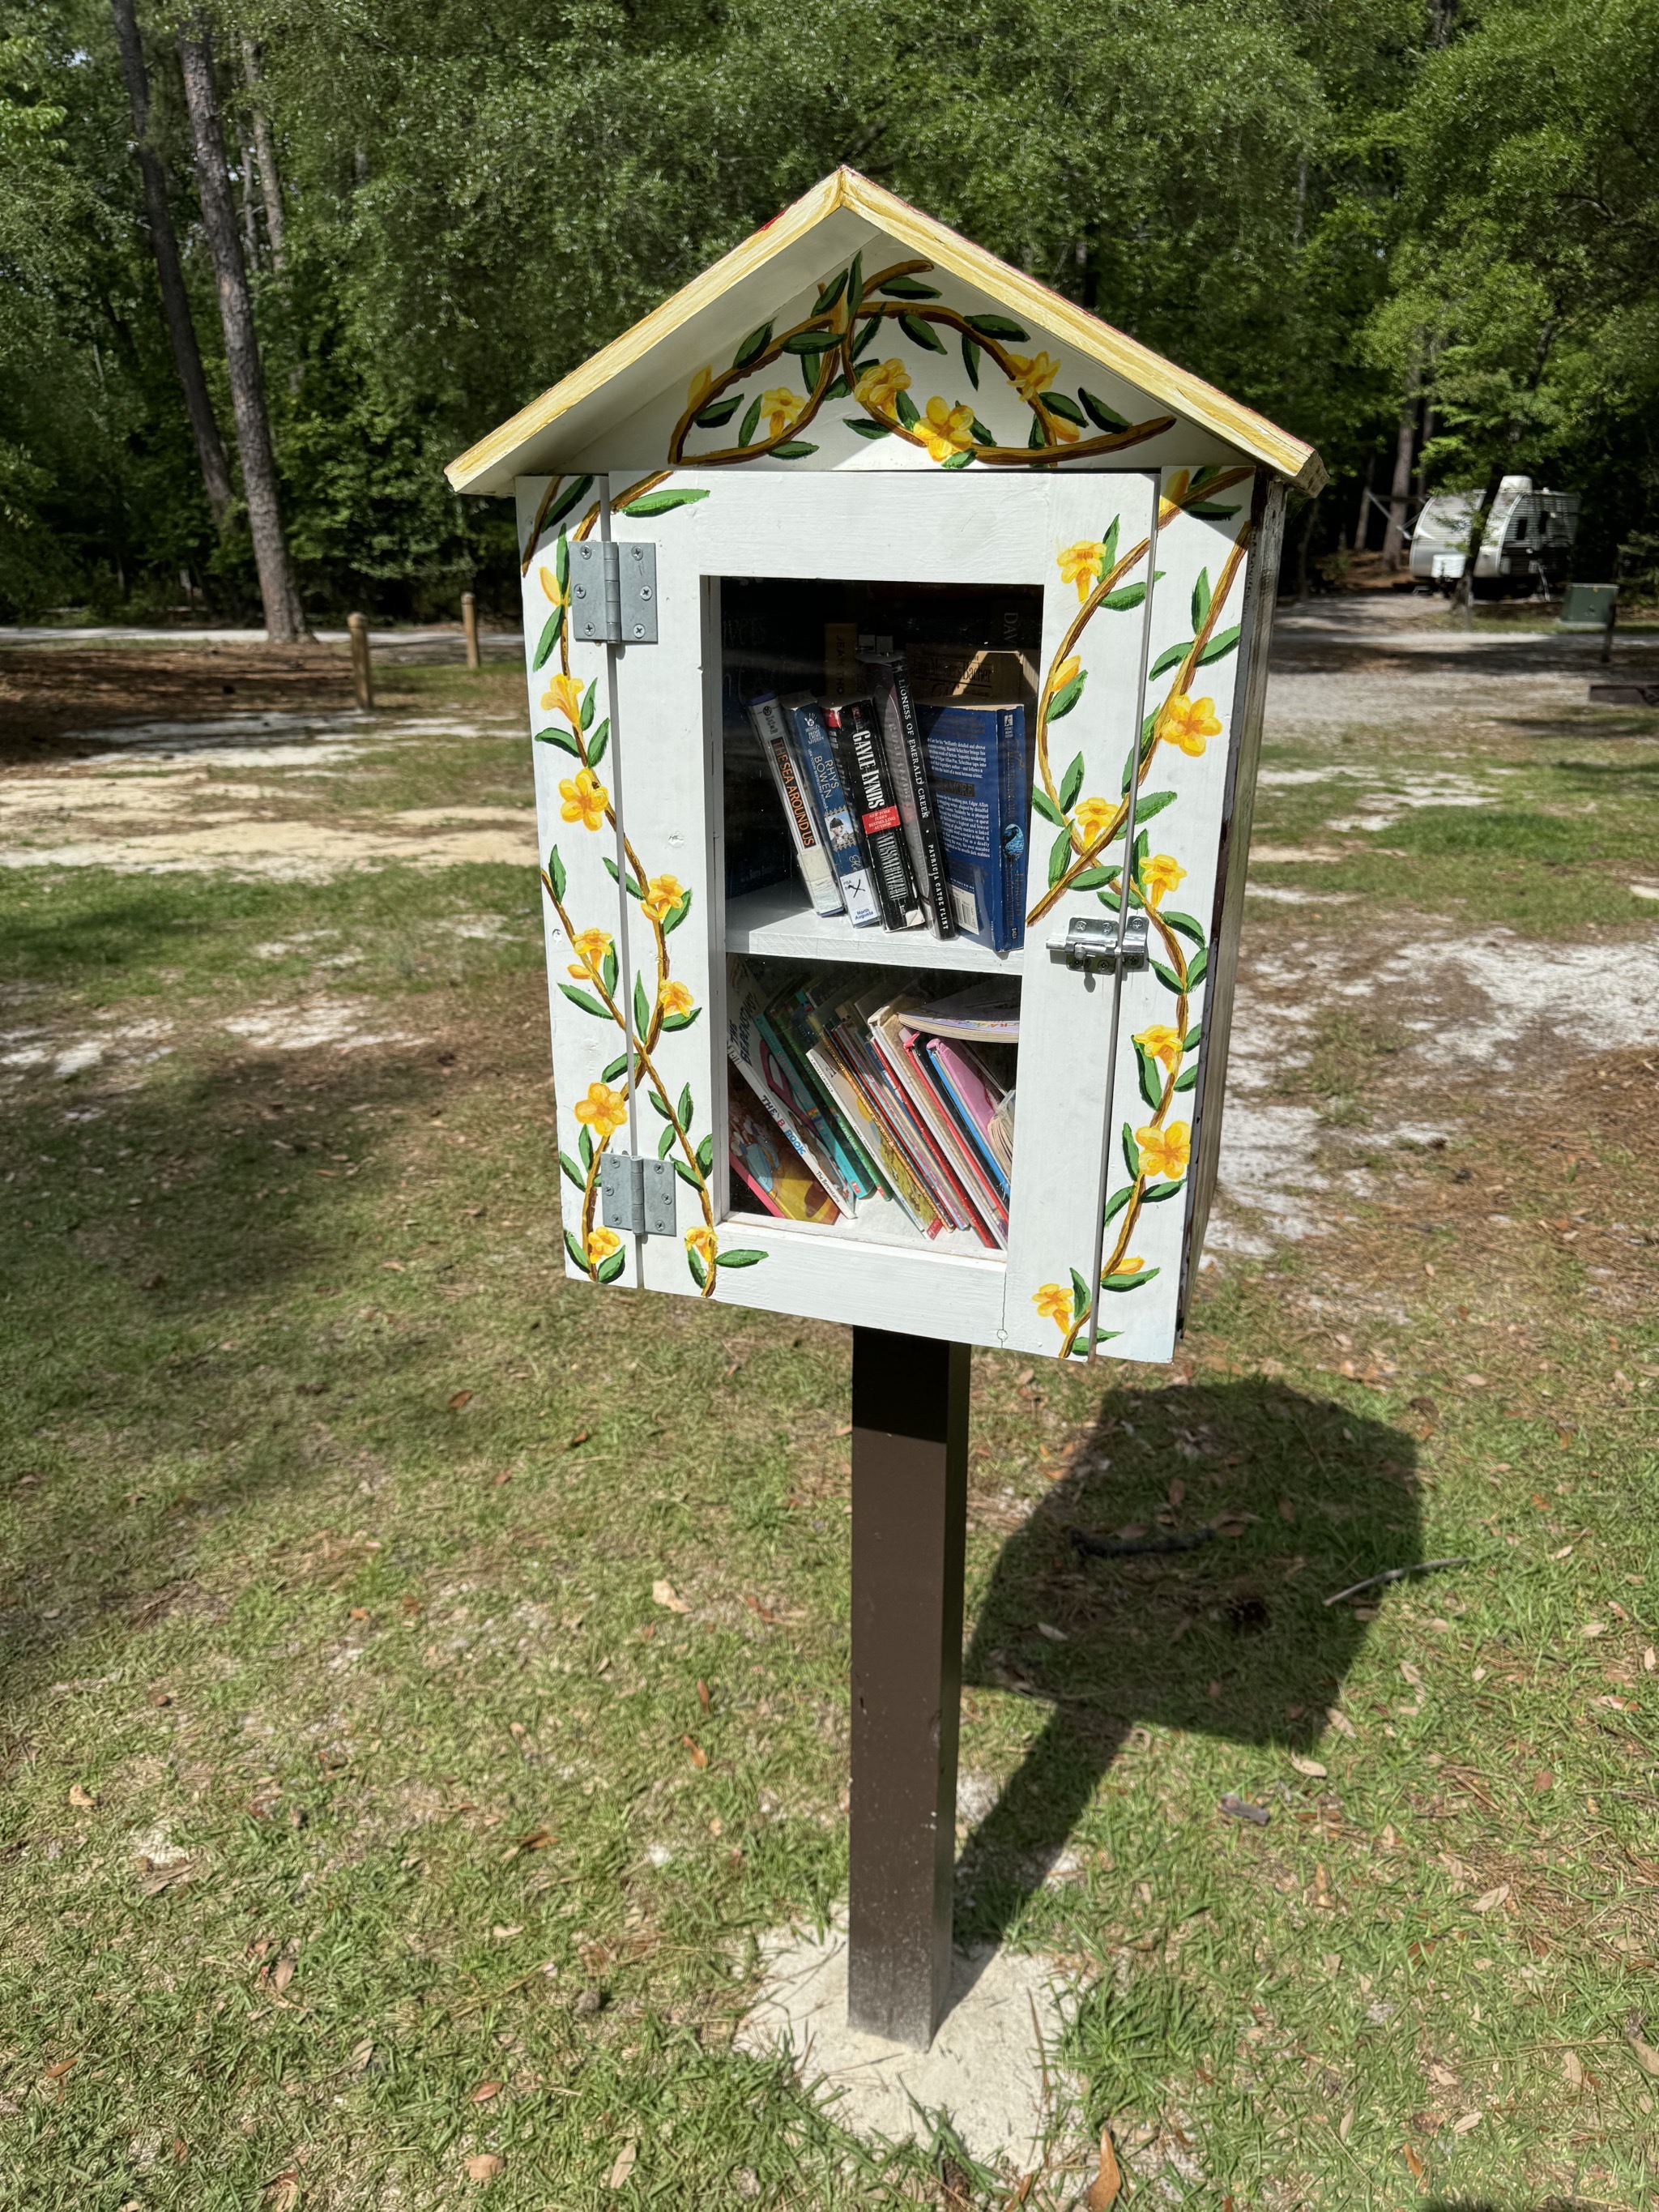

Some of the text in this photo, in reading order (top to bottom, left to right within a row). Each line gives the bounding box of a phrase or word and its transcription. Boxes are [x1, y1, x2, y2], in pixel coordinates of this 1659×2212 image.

[898, 679, 911, 720] LIONESS
[906, 723, 915, 736] OF
[772, 738, 789, 762] THE
[852, 729, 876, 770] GAYLE
[909, 738, 924, 785] EMERALD
[780, 762, 794, 785] SEA
[813, 755, 833, 799] BOWEN
[825, 759, 839, 789] RHYS
[861, 769, 885, 809] LYNDS
[786, 785, 809, 831] AROUND
[917, 788, 930, 819] CREEK
[801, 831, 815, 847] US
[928, 843, 949, 929] PATRICIA CATOE FLINT
[855, 911, 874, 920] Augusta
[729, 1018, 739, 1045] THE
[761, 1095, 807, 1155] THE B BOOK
[816, 1171, 840, 1203] The Berenstains
